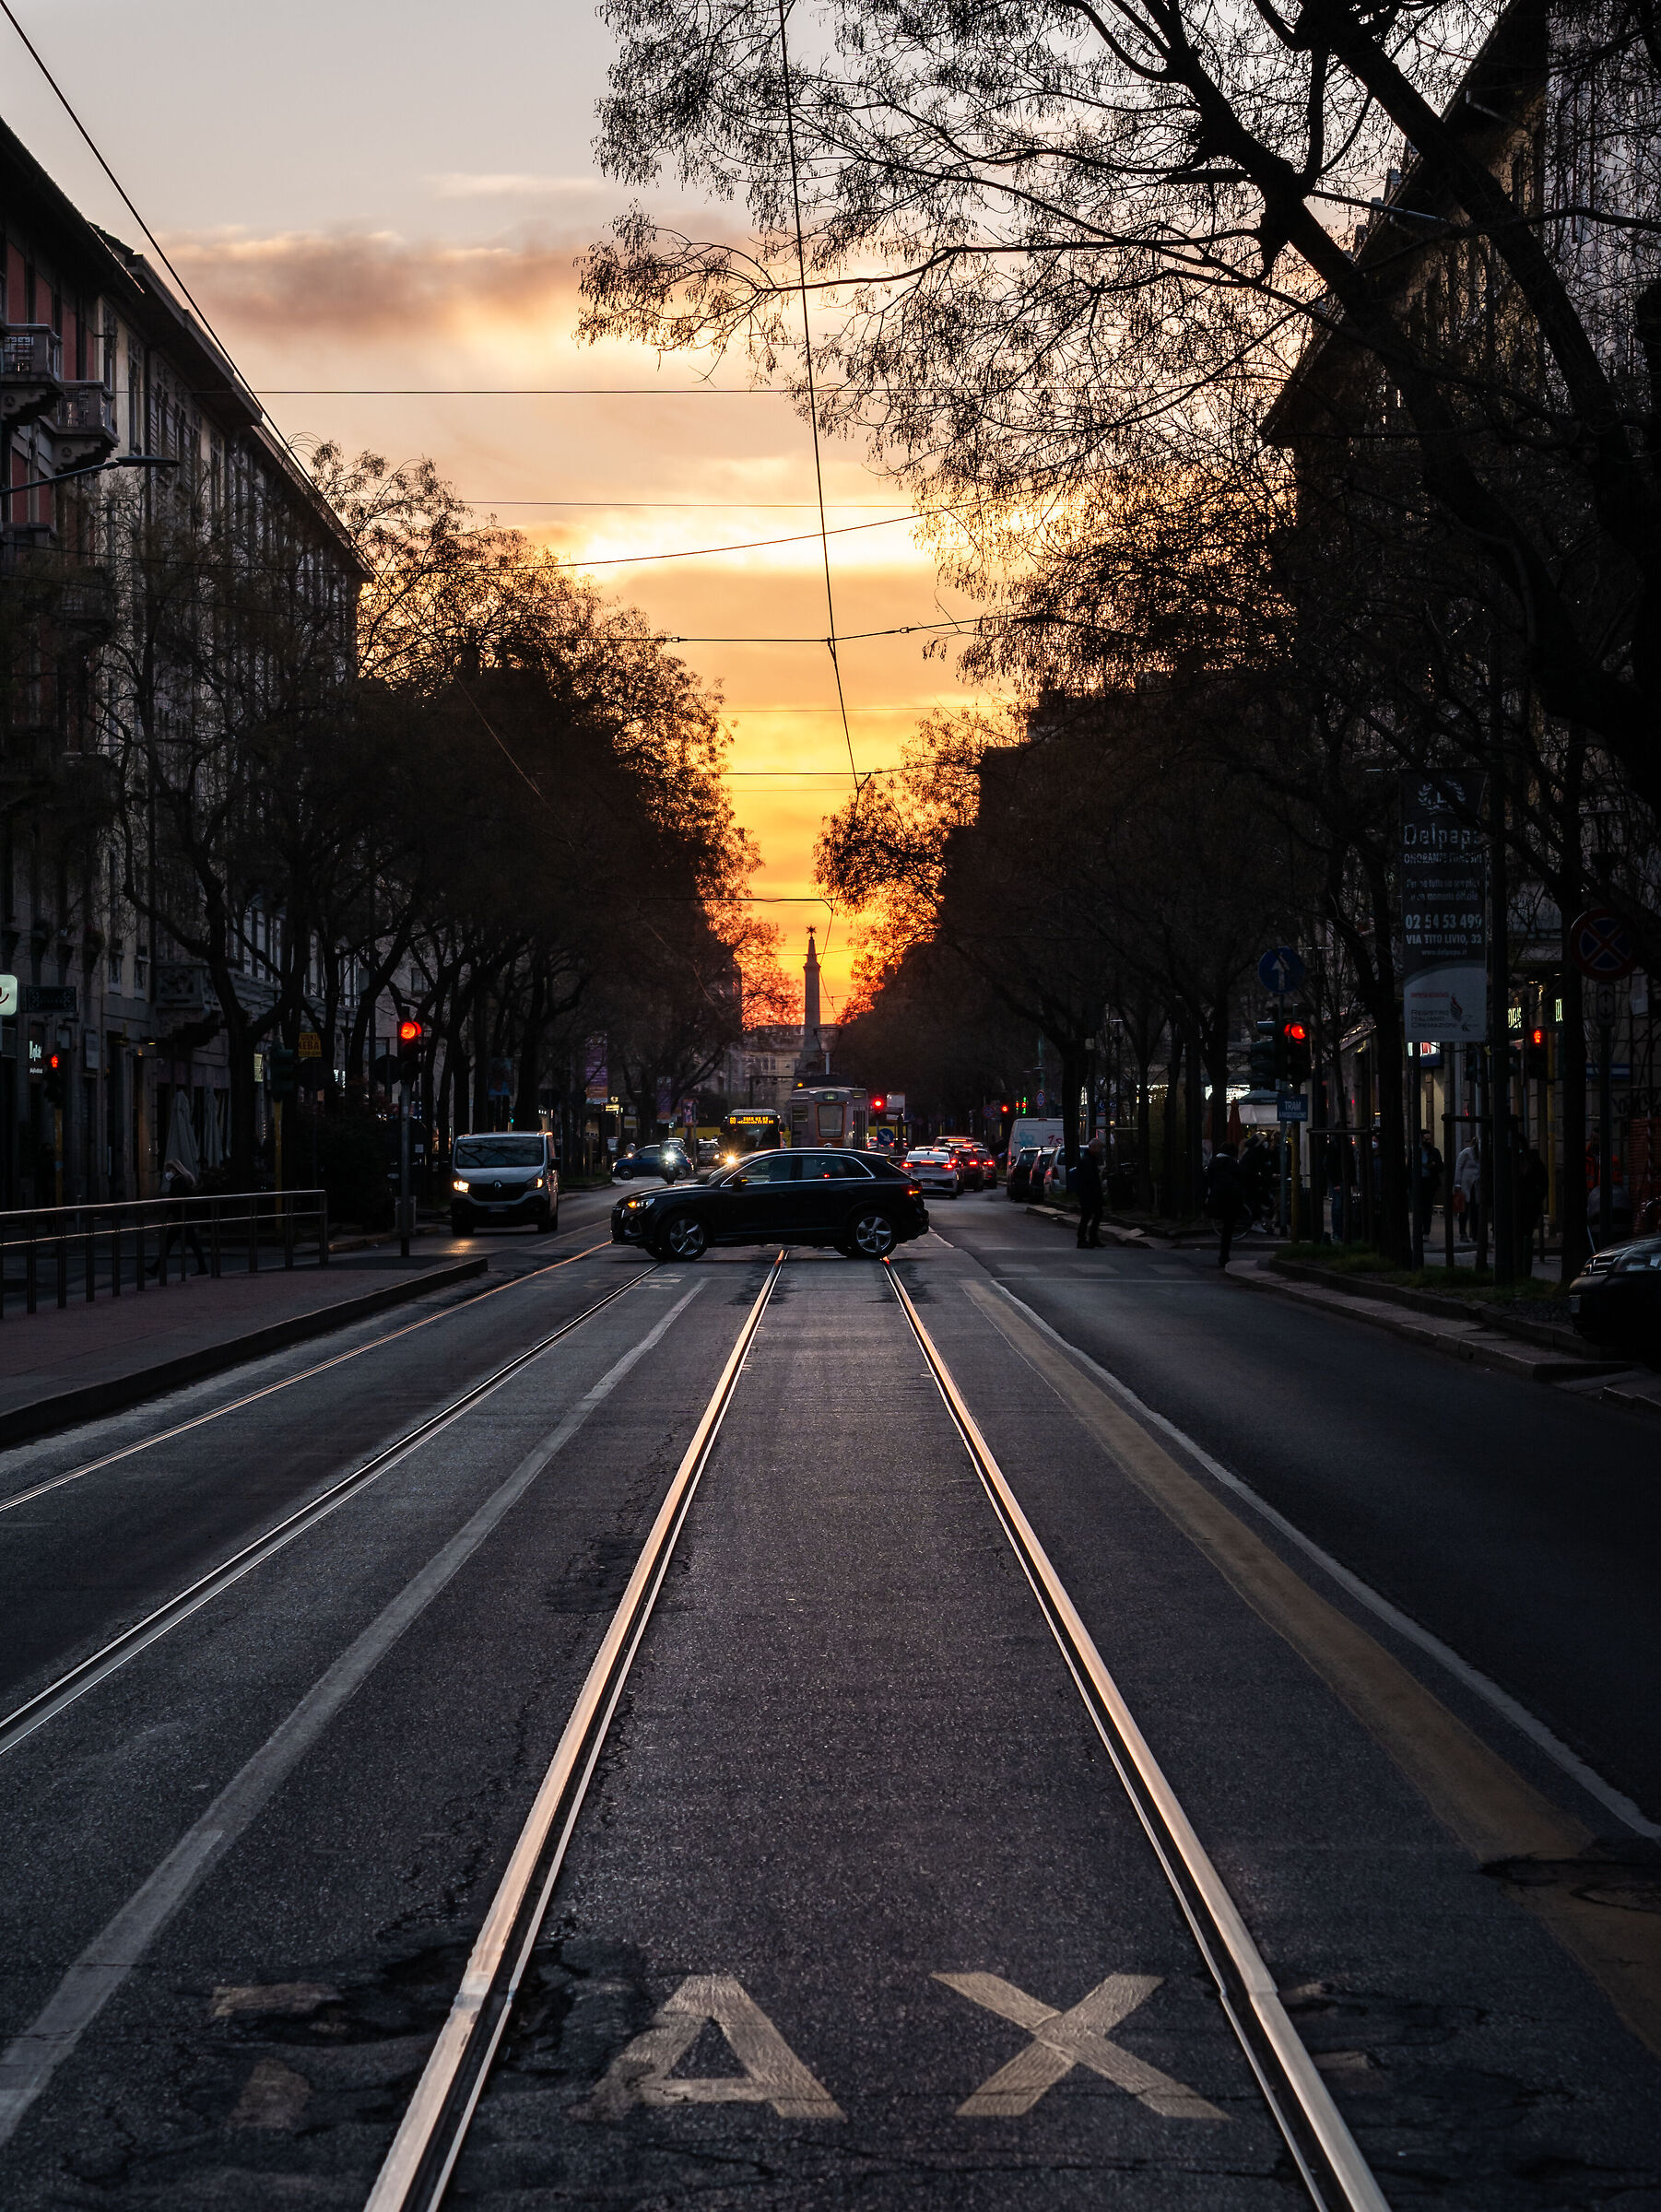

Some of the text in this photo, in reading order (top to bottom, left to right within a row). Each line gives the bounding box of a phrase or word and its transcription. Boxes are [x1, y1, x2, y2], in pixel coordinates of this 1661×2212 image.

[1405, 914, 1482, 929] 02 54 53 499
[1406, 934, 1482, 945] VIA TITO LIVIO, 32
[1284, 1100, 1302, 1112] TRAM
